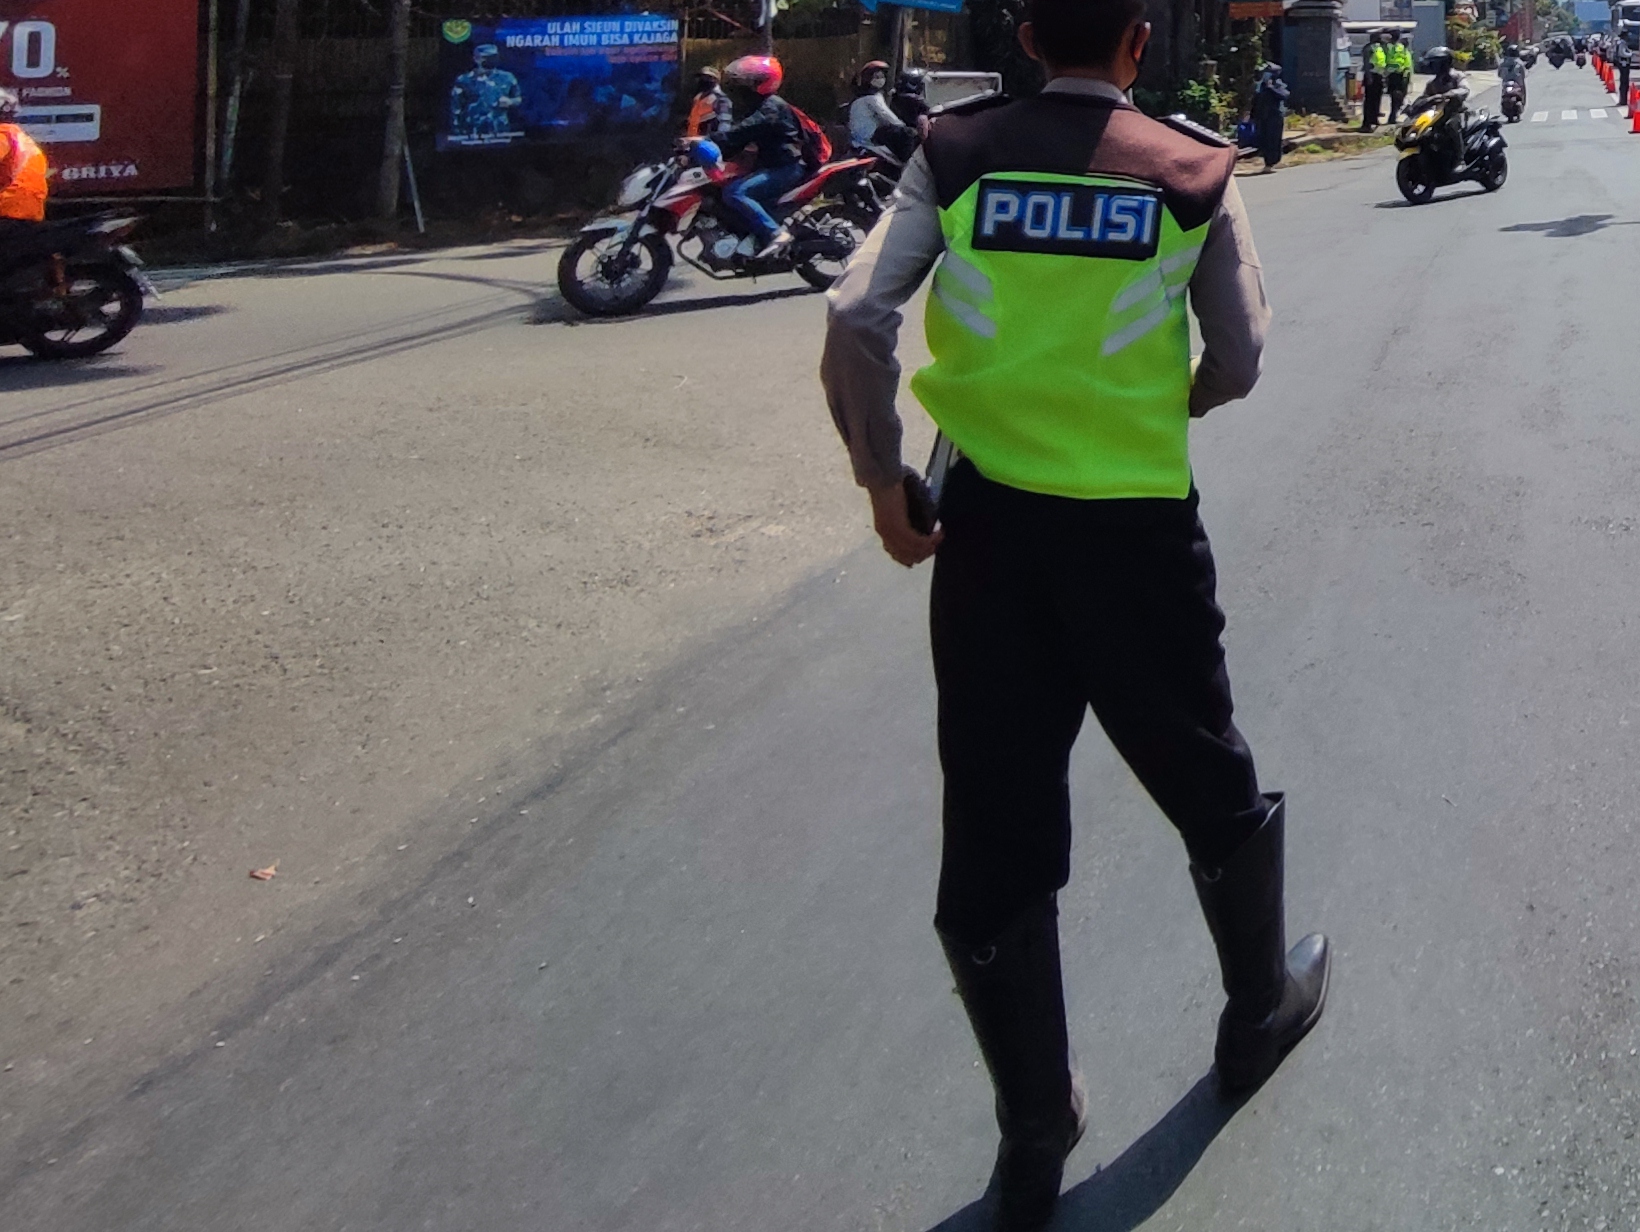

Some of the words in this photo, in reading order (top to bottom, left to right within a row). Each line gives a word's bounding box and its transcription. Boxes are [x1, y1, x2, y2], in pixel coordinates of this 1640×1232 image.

[624, 19, 679, 33] DIVAKSIN
[601, 32, 629, 45] BISA
[633, 31, 679, 44] KAJAGA
[61, 164, 138, 180] GRIYA
[982, 188, 1158, 245] POLISI
